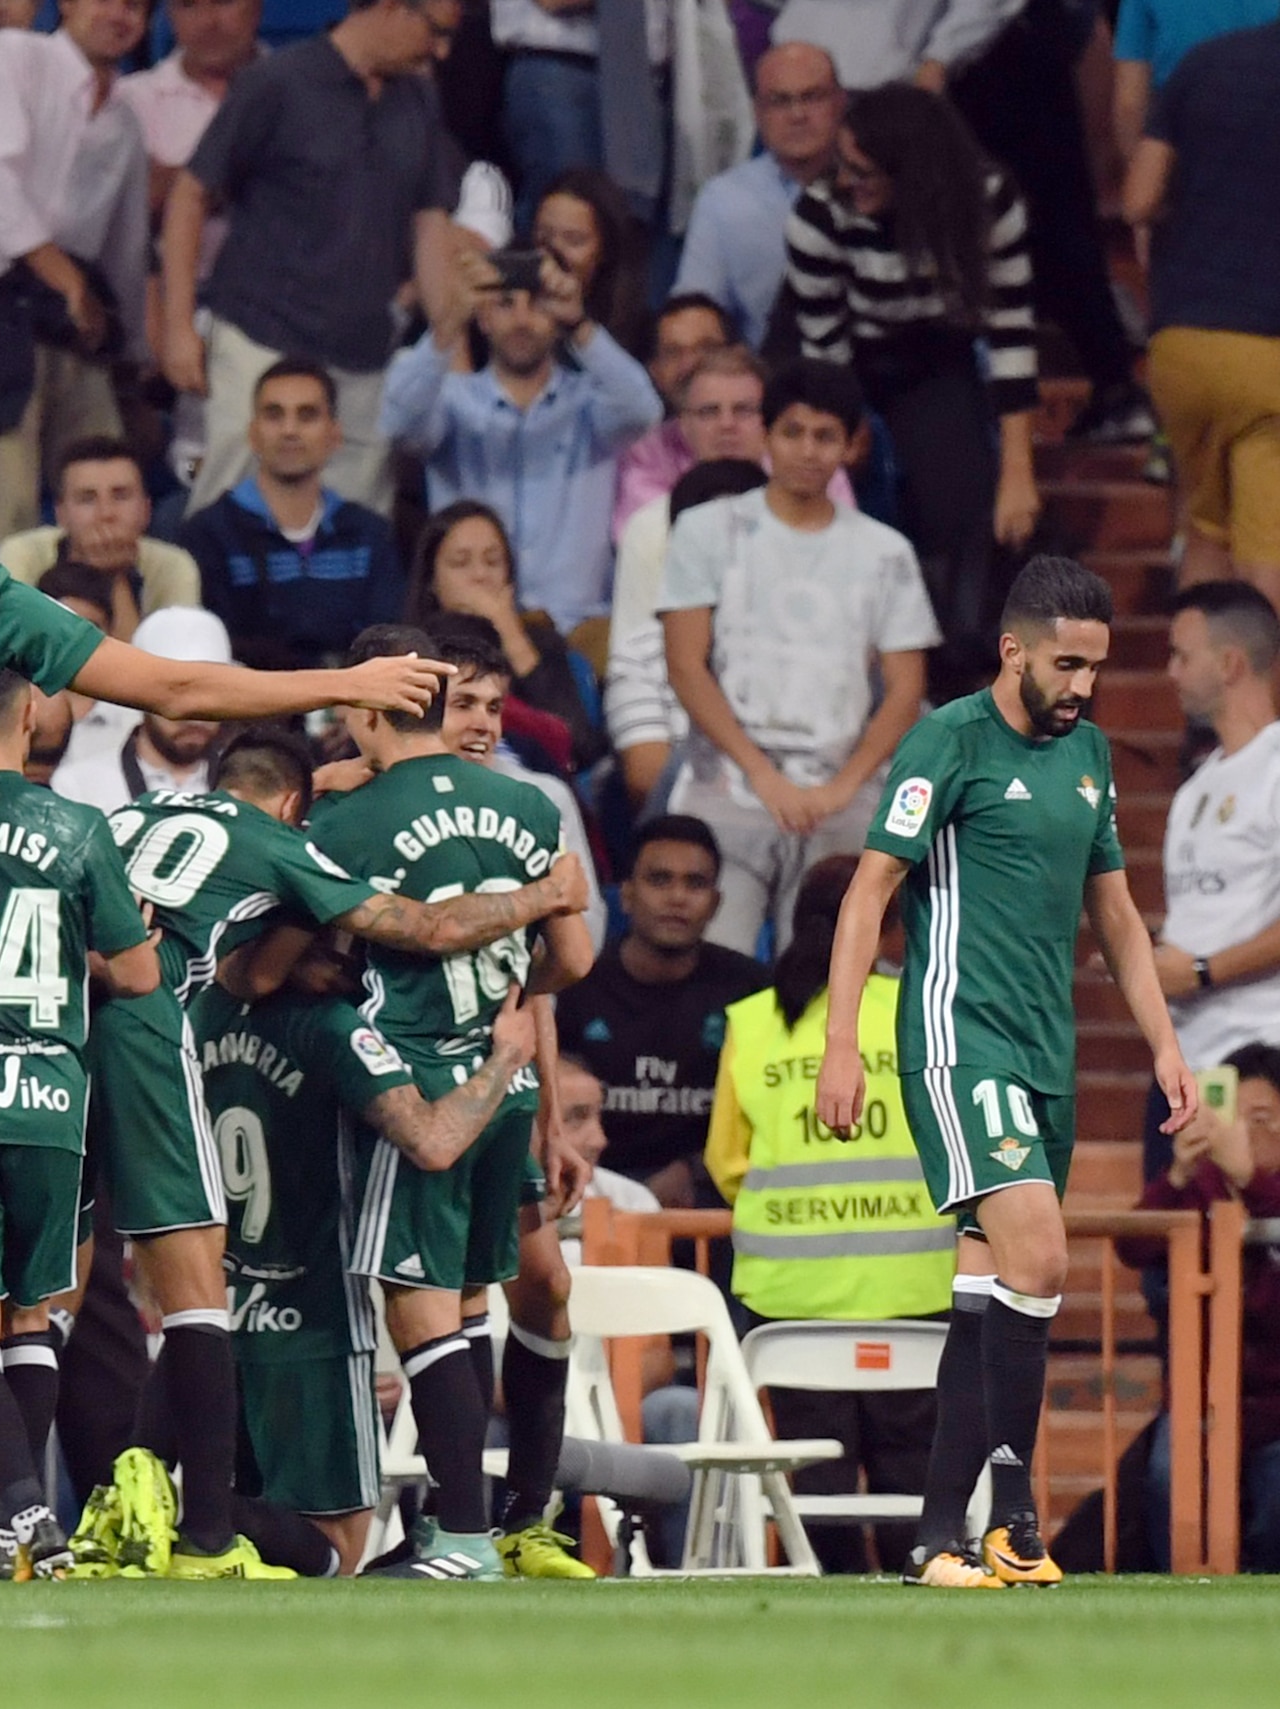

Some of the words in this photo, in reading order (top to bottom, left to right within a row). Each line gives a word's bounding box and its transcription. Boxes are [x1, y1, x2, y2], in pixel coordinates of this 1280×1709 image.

[393, 806, 550, 878] GUARDADO
[972, 1079, 1038, 1138] 10
[215, 1106, 270, 1243] 9
[765, 1194, 922, 1226] SERVIMAX
